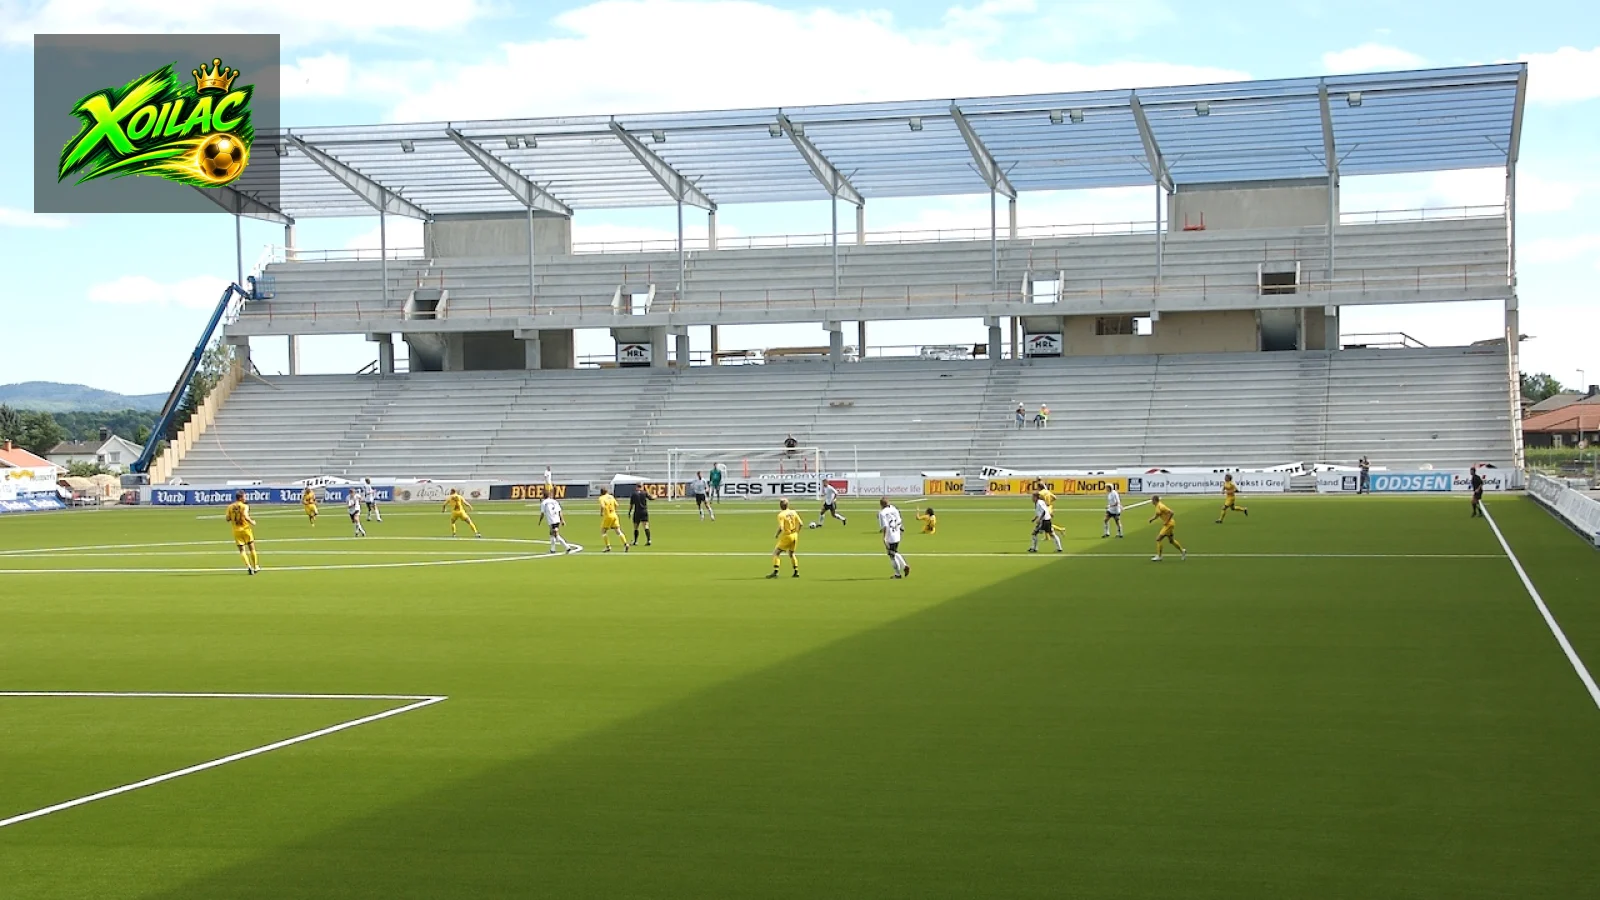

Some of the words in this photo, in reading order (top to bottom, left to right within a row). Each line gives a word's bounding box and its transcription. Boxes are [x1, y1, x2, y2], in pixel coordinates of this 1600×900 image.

[1146, 479, 1165, 488] Yara
[194, 489, 232, 503] Varden
[511, 485, 566, 499] BYGEN
